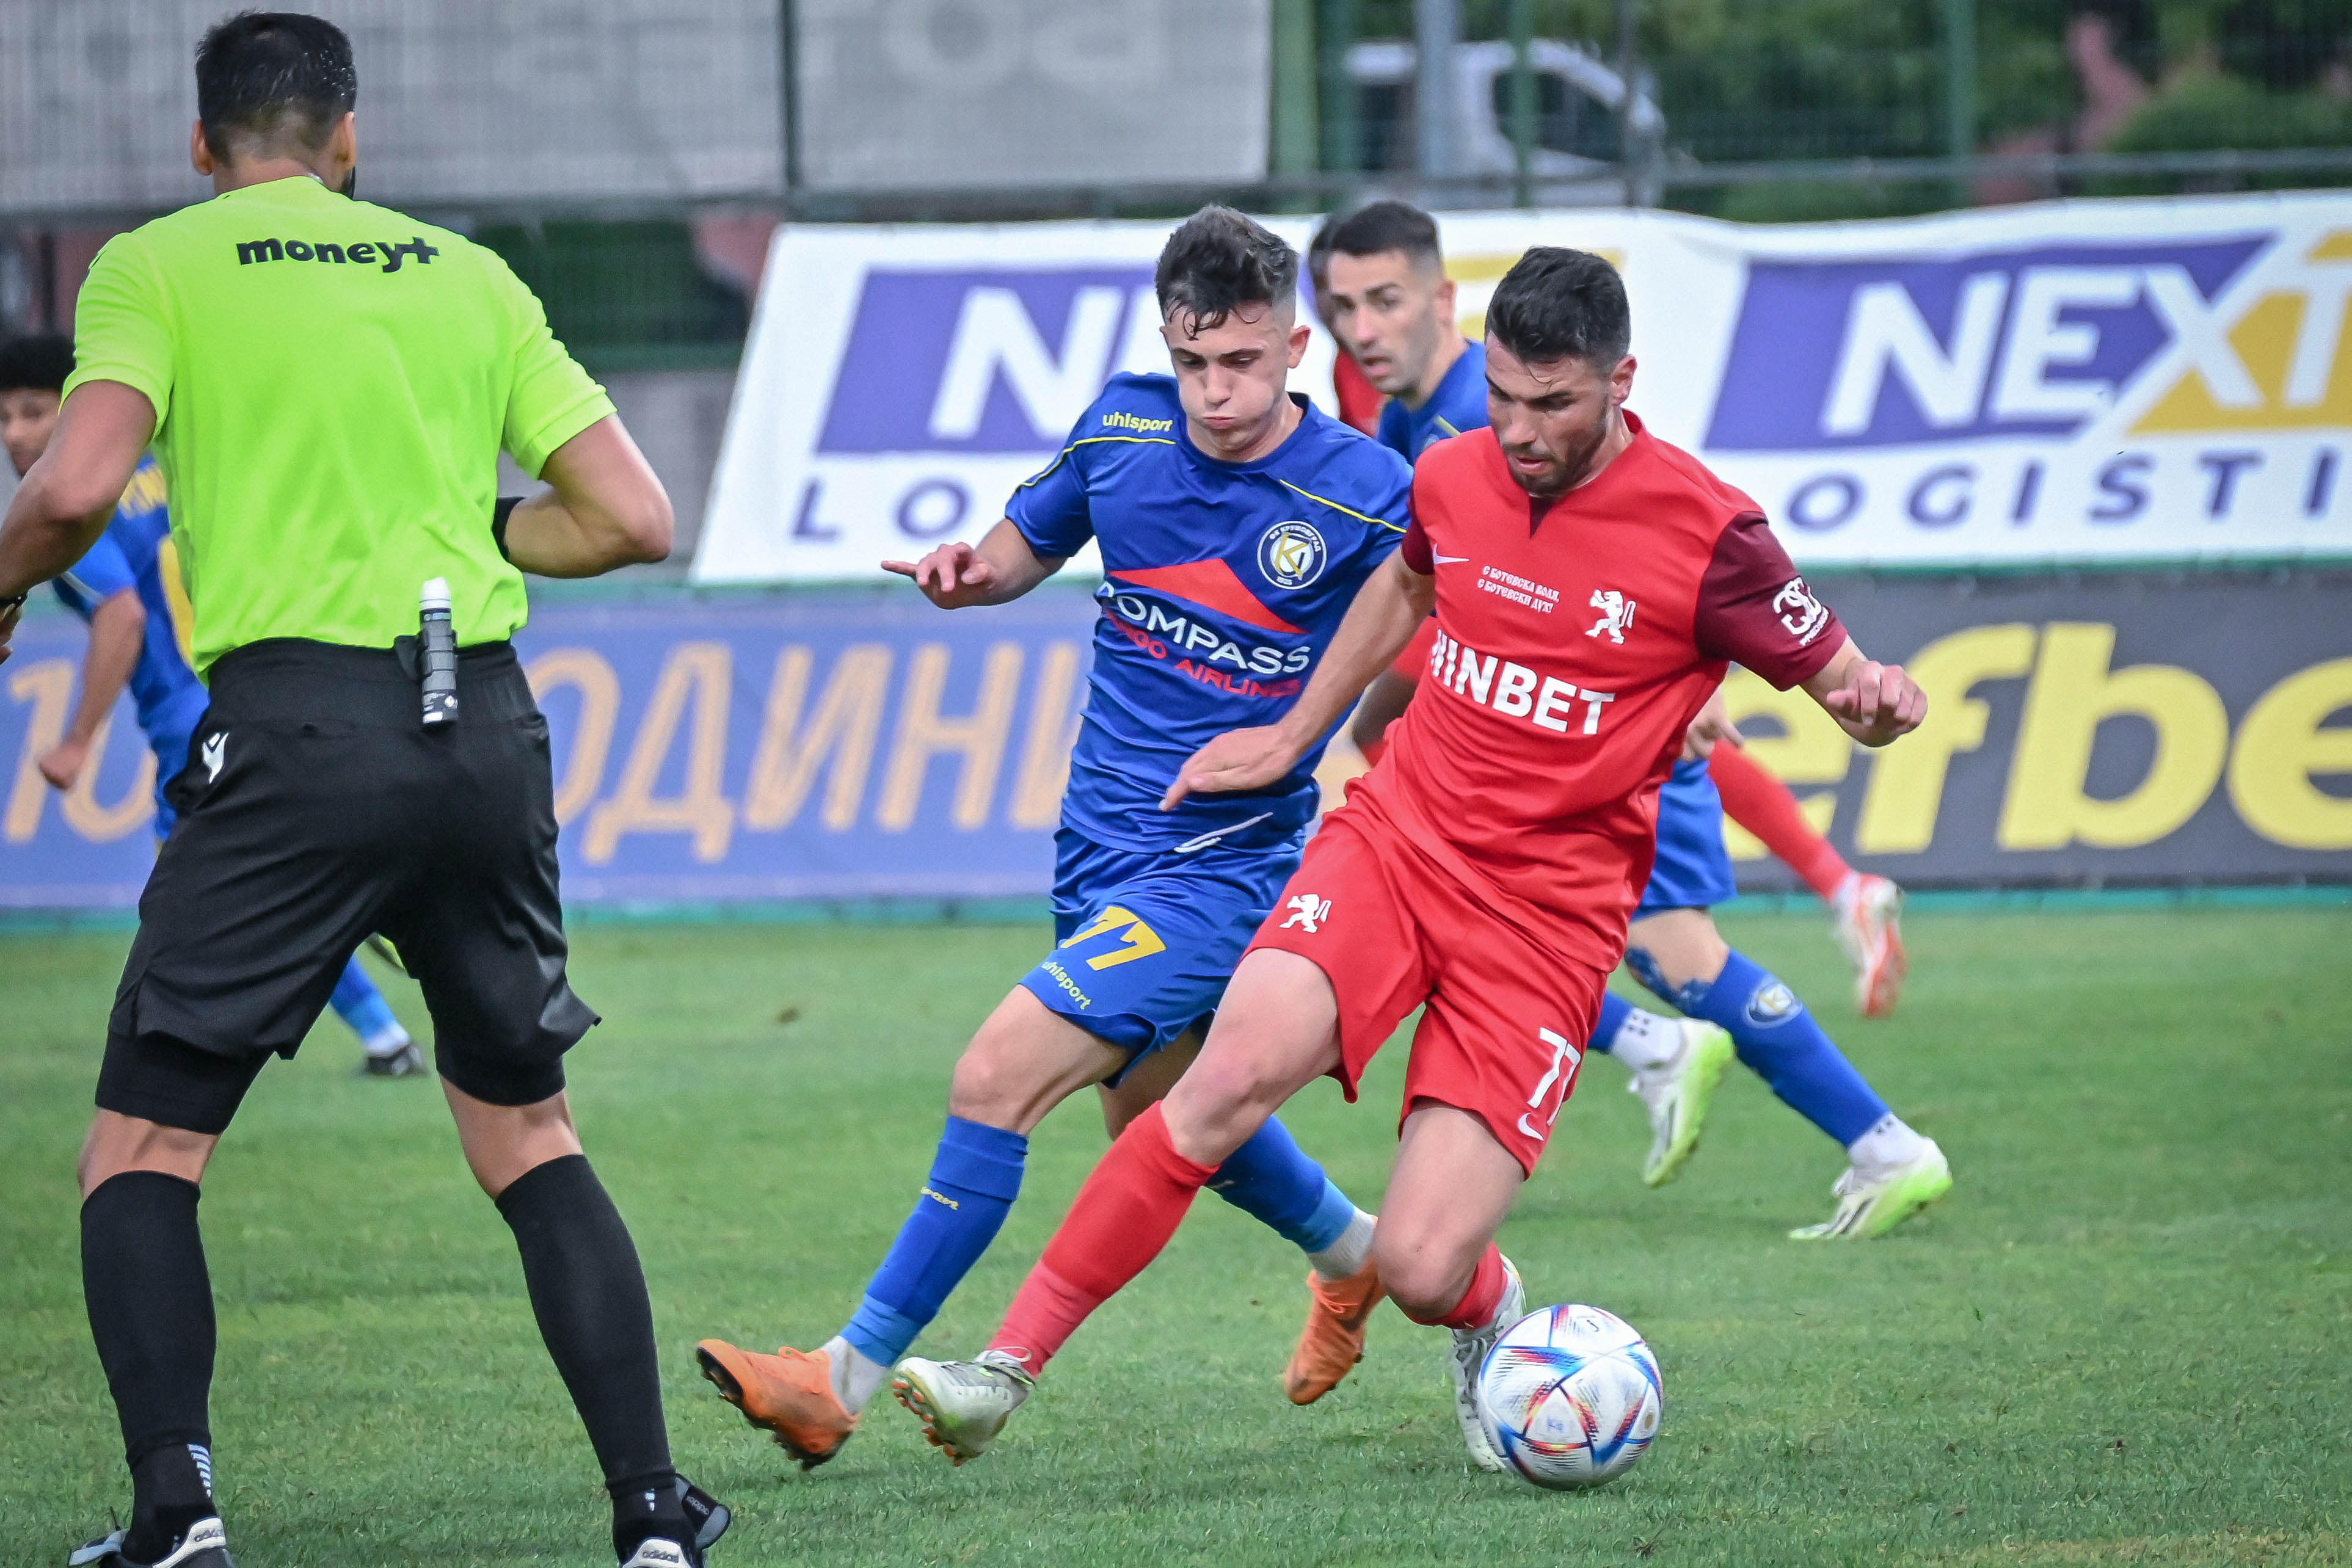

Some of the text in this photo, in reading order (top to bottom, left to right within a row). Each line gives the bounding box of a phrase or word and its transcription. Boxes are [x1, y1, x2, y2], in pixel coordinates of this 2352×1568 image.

[1821, 264, 2352, 438] NEXT
[1102, 412, 1173, 432] uhlsport
[1041, 962, 1092, 1010] uhlsport
[1527, 1026, 1581, 1126] 77
